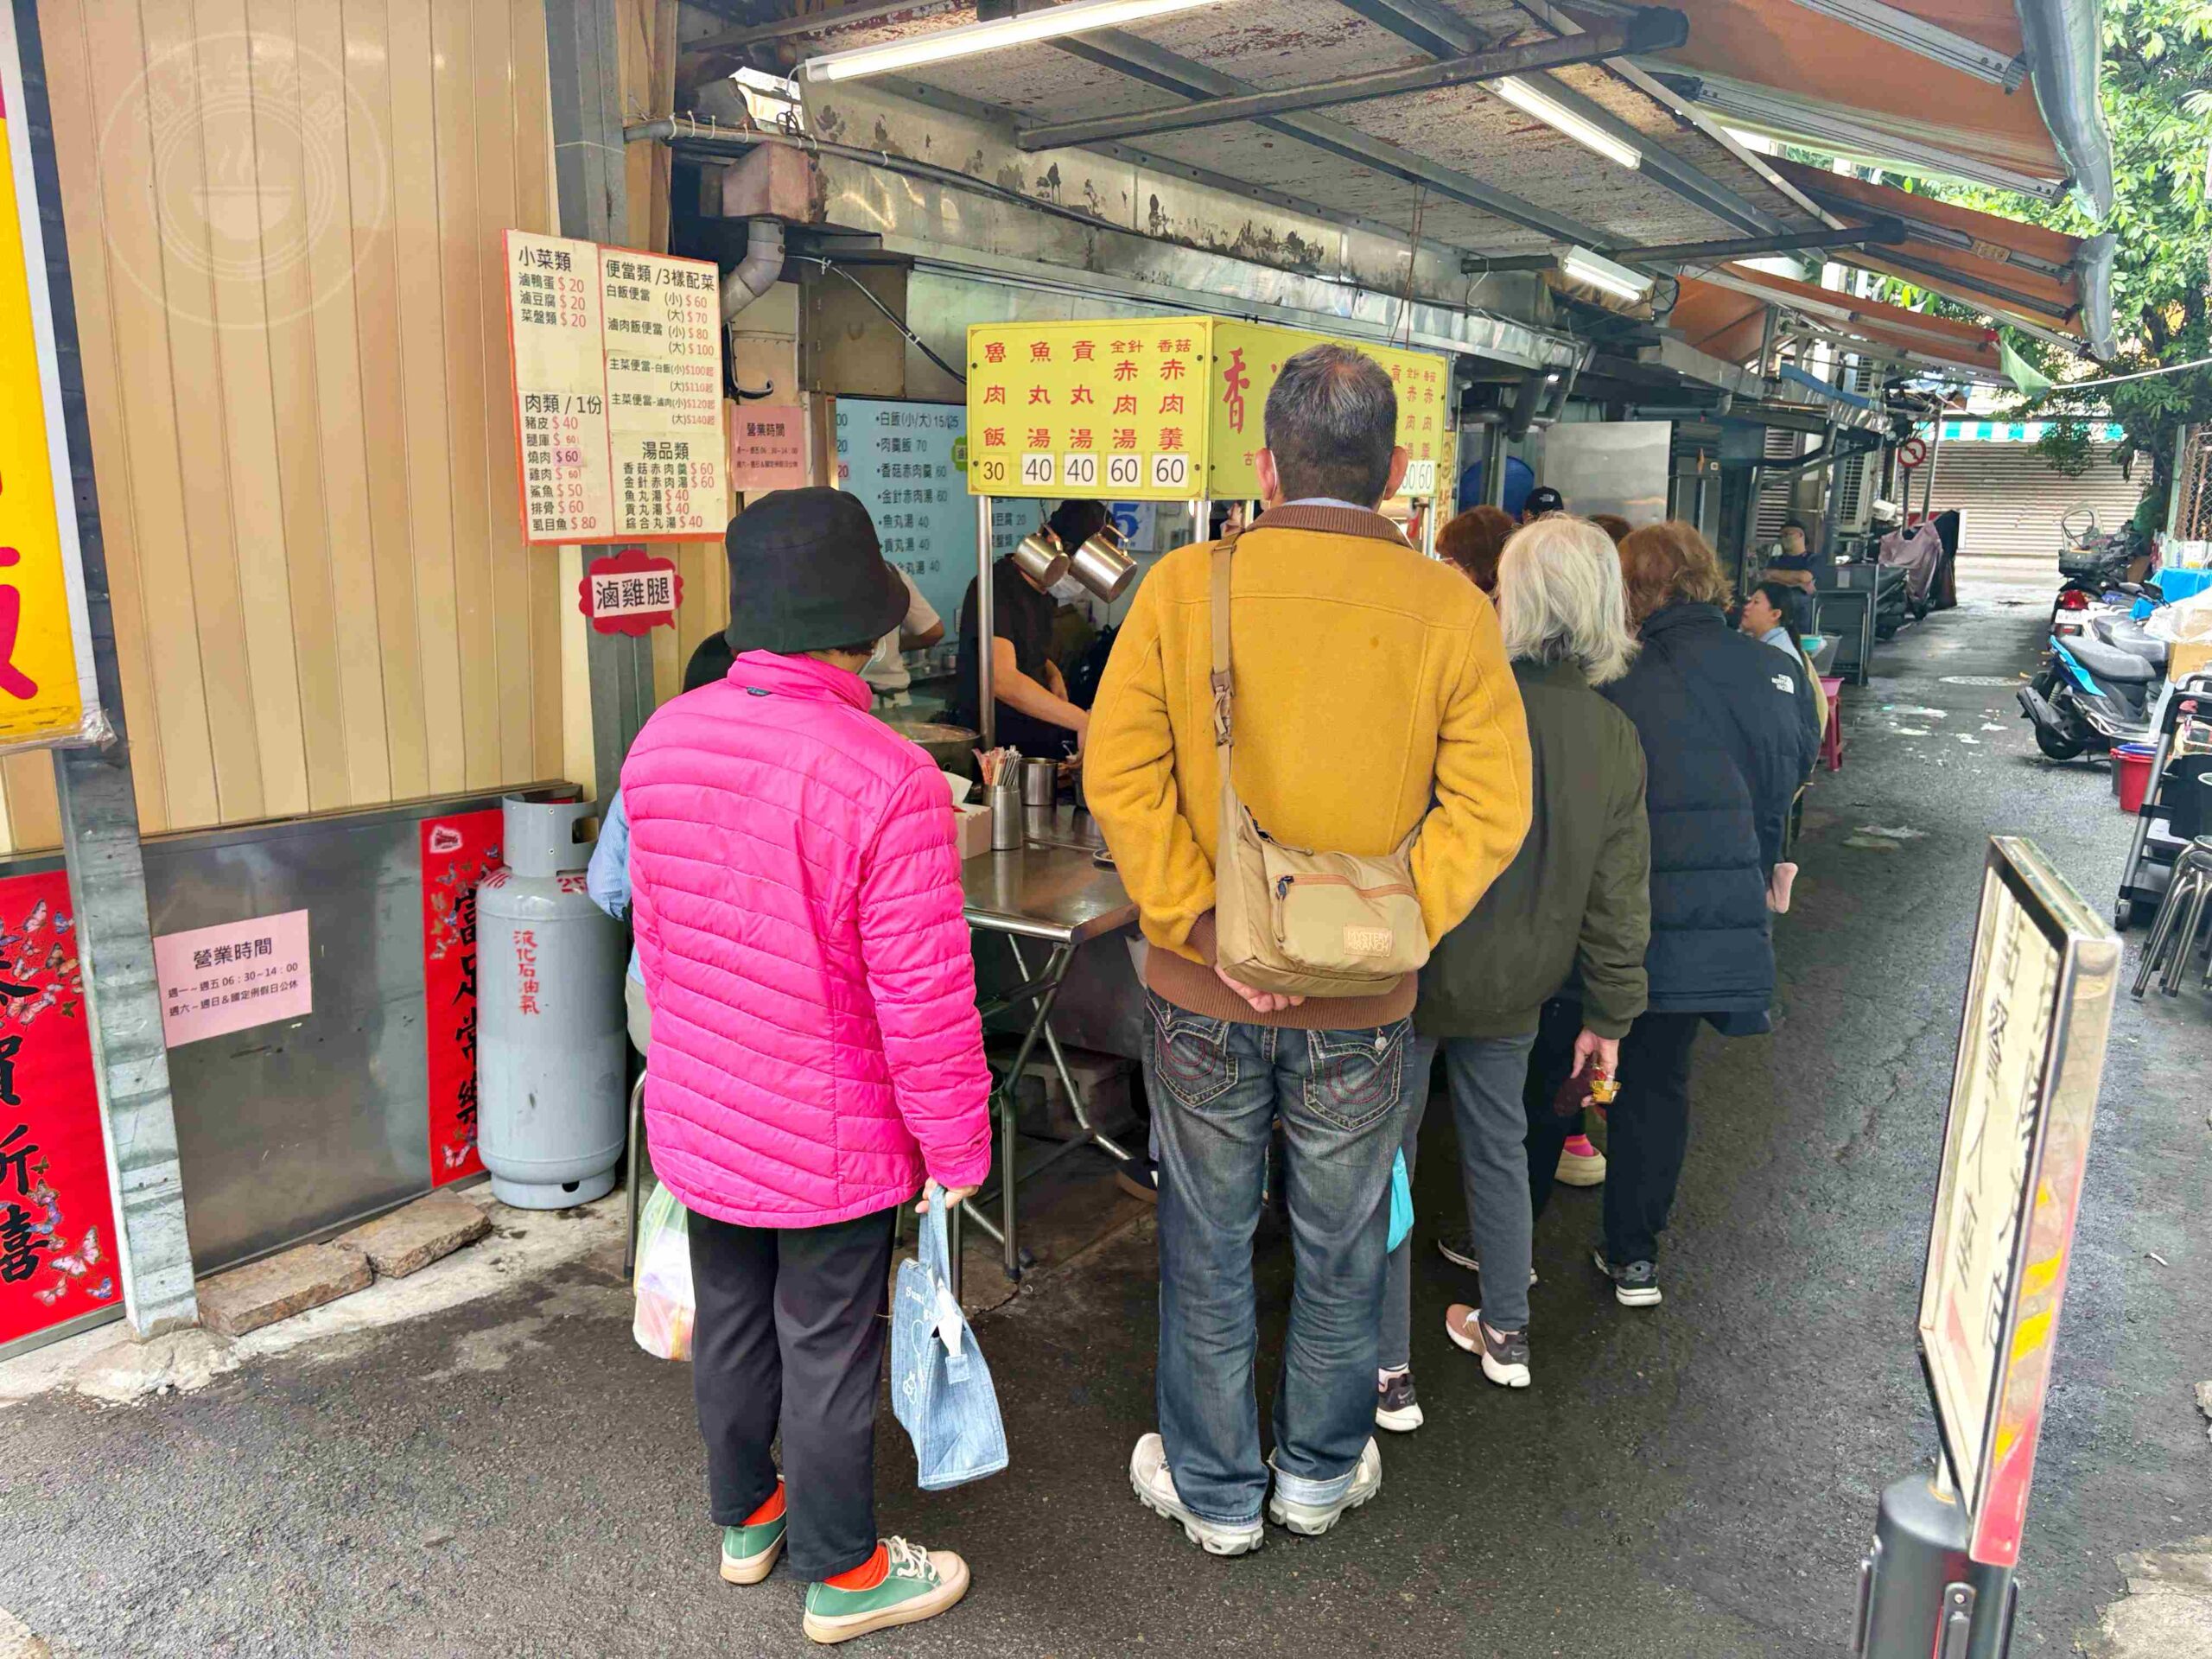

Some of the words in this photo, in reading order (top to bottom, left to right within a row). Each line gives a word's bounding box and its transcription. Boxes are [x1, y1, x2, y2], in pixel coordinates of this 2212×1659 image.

[518, 245, 572, 272] 小菜類
[518, 271, 555, 289] 滷鴨蛋
[606, 258, 652, 283] 便當類
[519, 289, 556, 308] 滷豆腐
[607, 284, 651, 302] 白飯便當
[520, 308, 557, 326] 菜盤類
[607, 316, 663, 336] 滷肉飯便當
[524, 393, 560, 414] 肉類
[576, 395, 602, 415] 1份
[1027, 340, 1052, 449] 魚丸湯
[1070, 340, 1096, 449] 貢丸湯
[524, 416, 549, 429] 豬皮
[642, 441, 690, 460] 湯品類
[916, 439, 927, 452] 70
[527, 450, 551, 464] 燒肉
[529, 467, 552, 481] 雞肉
[983, 461, 1004, 480] 30
[1026, 458, 1052, 481] 40
[1066, 458, 1094, 482] 40
[1110, 458, 1138, 482] 60
[1156, 458, 1185, 483] 60
[1418, 464, 1433, 490] 60
[624, 489, 662, 502] 魚丸湯
[531, 501, 554, 515] 排骨
[625, 503, 663, 516] 貢丸湯
[532, 518, 568, 531] 虱目魚
[596, 576, 670, 610] 滷雞腿
[193, 937, 273, 969] 營業時間
